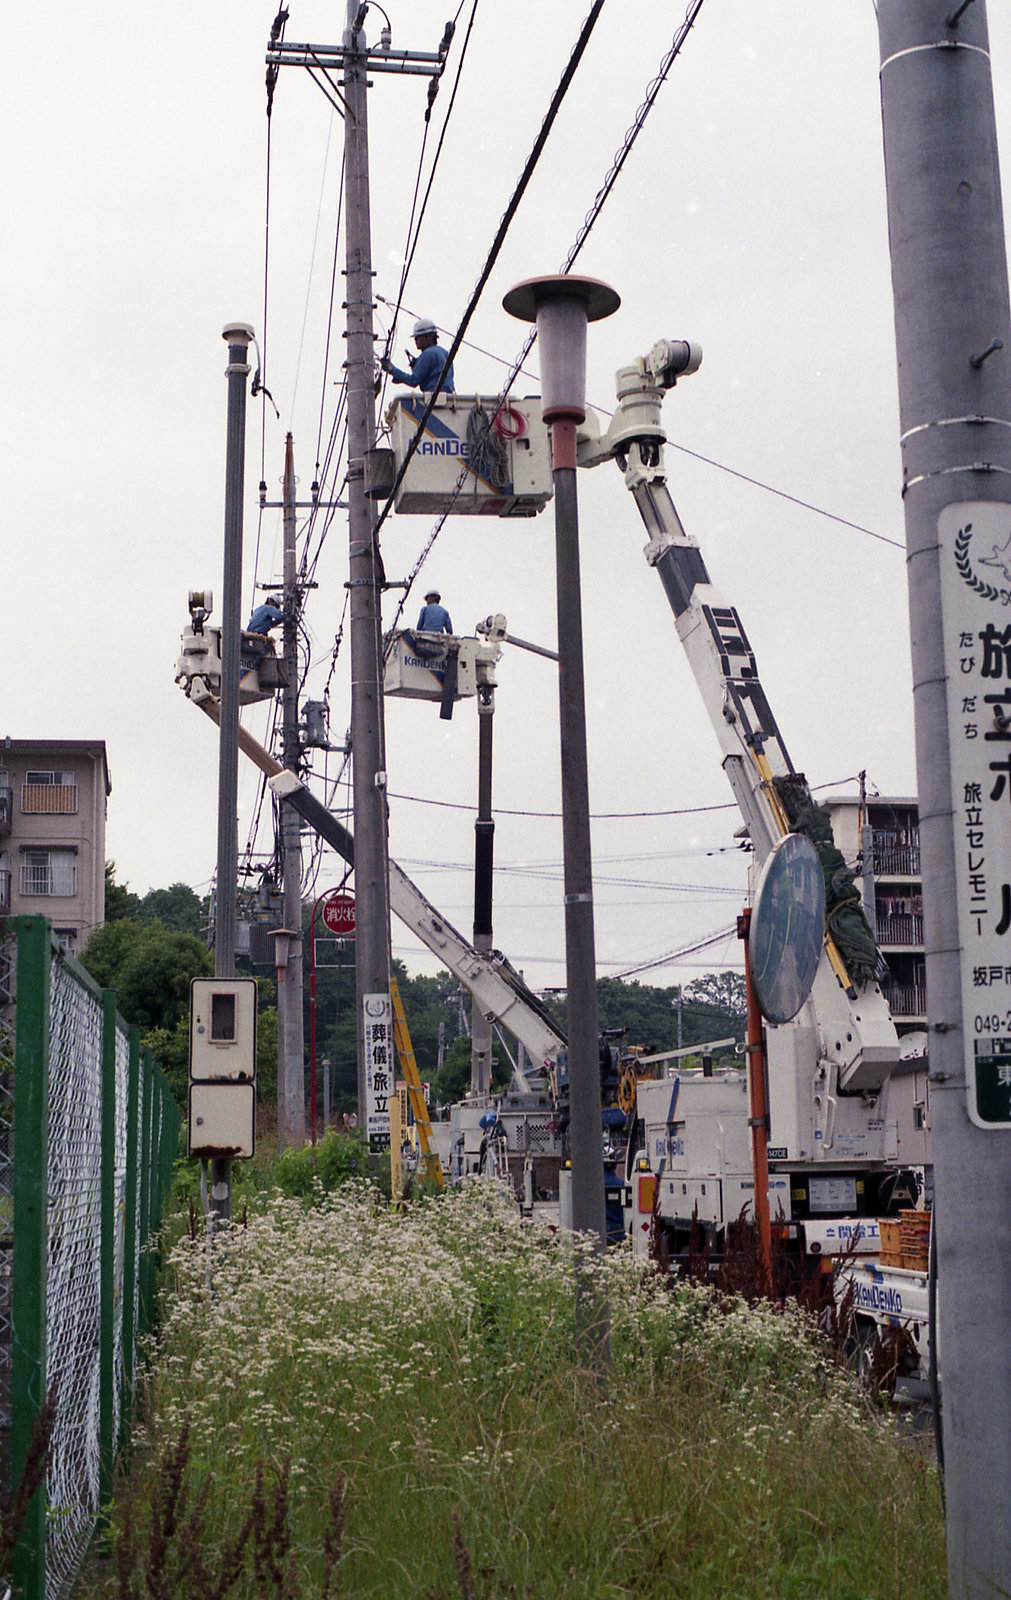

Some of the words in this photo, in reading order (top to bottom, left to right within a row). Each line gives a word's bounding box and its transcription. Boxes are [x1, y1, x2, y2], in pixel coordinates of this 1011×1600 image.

[963, 782, 988, 937] 旅立セレモニー
[371, 1023, 389, 1113] 葬儀・旅立
